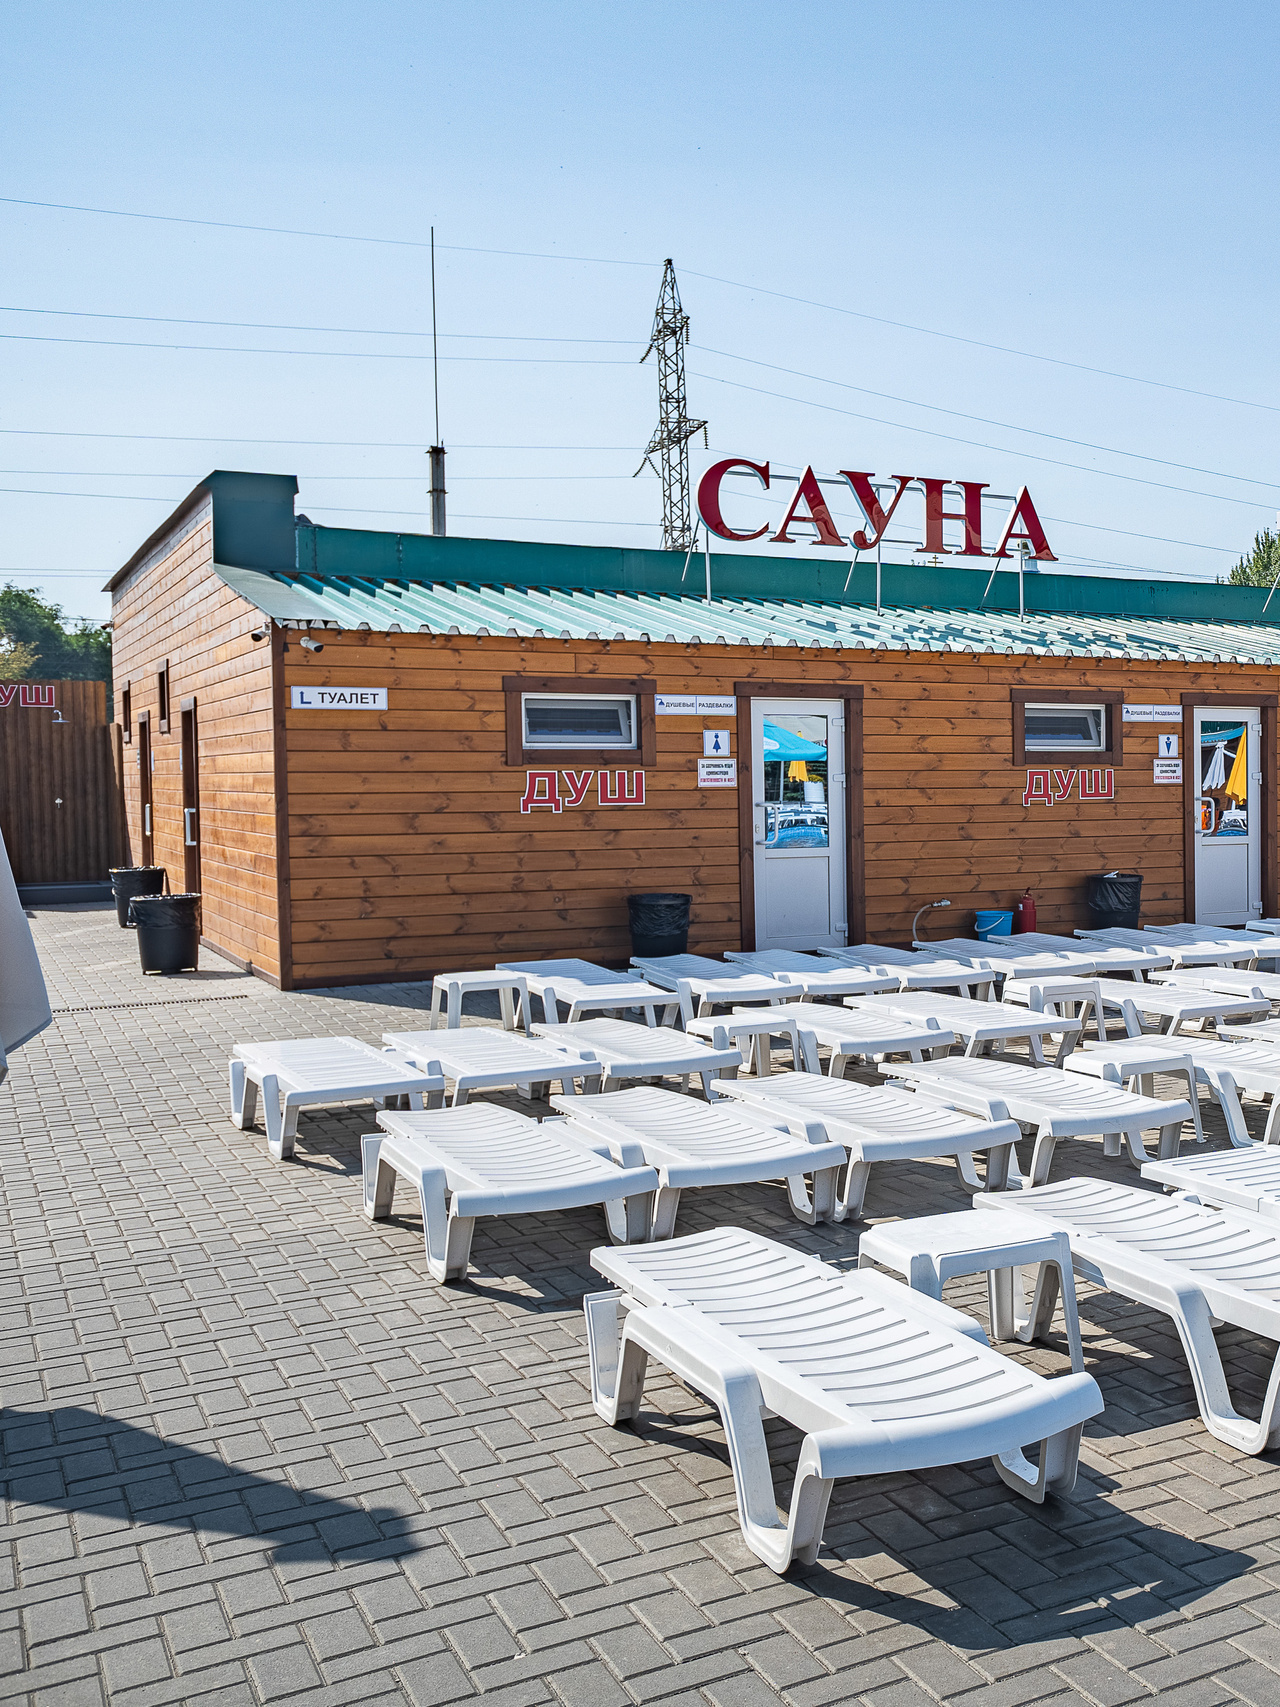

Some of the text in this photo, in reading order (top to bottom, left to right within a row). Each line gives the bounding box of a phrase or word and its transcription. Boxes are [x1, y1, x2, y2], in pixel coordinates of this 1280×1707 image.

[695, 458, 1059, 562] САУНА
[0, 684, 55, 708] УШ
[317, 692, 380, 704] ТУАЛЕТ
[520, 770, 646, 814] ДУШ
[1022, 769, 1115, 807] ДУШ
